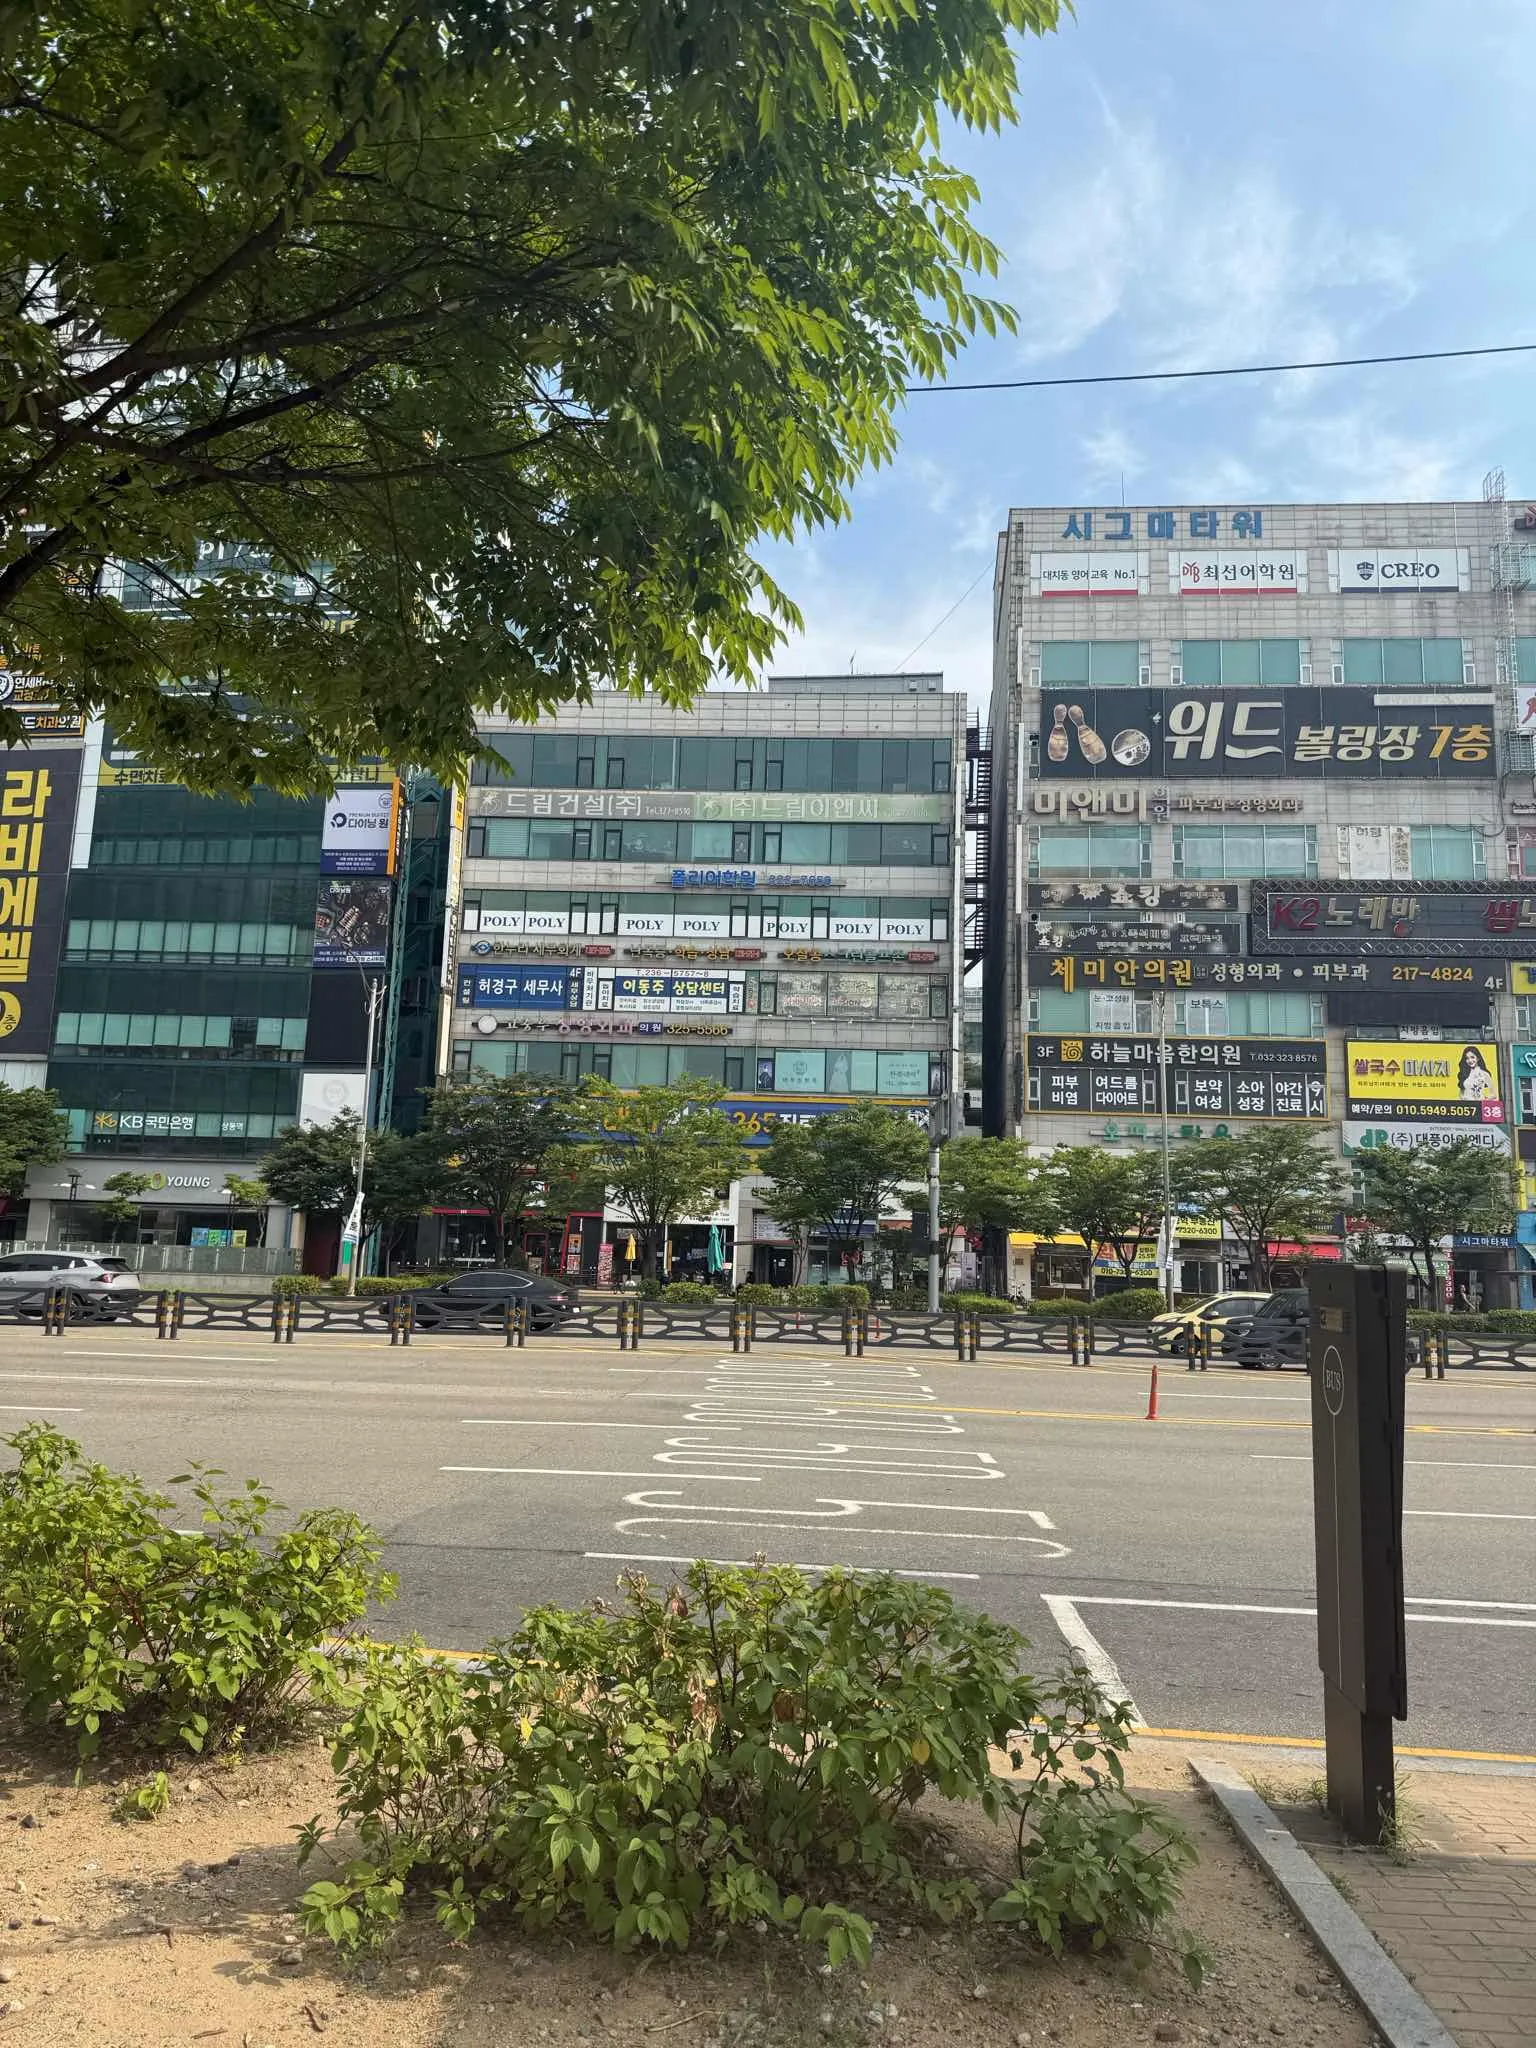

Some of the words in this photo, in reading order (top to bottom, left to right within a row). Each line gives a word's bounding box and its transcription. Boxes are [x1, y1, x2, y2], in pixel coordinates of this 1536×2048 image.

[1062, 510, 1263, 541] 시그마타워
[1042, 569, 1069, 580] 대치동
[1071, 569, 1108, 580] 영어교육
[1114, 568, 1136, 580] No.1
[1203, 564, 1294, 582] 최선어학원
[1380, 562, 1439, 579] CREO
[1164, 701, 1283, 760] 위드
[1294, 725, 1419, 761] 볼링장
[1428, 724, 1491, 761] 7층
[506, 793, 641, 817] 드림건설(주)
[1034, 788, 1147, 822] 미앤미
[672, 869, 756, 888] 폴리어학원
[483, 916, 520, 927] POLY
[528, 917, 565, 928] POLY
[1273, 896, 1321, 930] K2
[1325, 896, 1422, 938] 노래방
[626, 919, 664, 930] POLY
[683, 920, 720, 931] POLY
[767, 922, 808, 933] POLY
[835, 924, 873, 934] POLY
[886, 925, 925, 935] POLY
[569, 968, 582, 978] 4F
[1210, 963, 1284, 982] 성형외과
[1312, 963, 1369, 981] 피부과
[1392, 967, 1473, 981] 217-4824
[478, 978, 518, 995] 허경구
[523, 980, 564, 996] 세무사
[622, 979, 665, 995] 이동주
[672, 981, 725, 996] 상담센터
[1485, 977, 1503, 989] 4F
[639, 1023, 662, 1033] 의원
[1037, 1046, 1054, 1057] 3F
[1090, 1044, 1241, 1065] 하늘마음한의원
[1354, 1058, 1400, 1076] 쌀국수
[1051, 1076, 1079, 1088] 피부
[1095, 1076, 1138, 1090] 여드름
[1194, 1080, 1222, 1093] 보약
[1236, 1080, 1264, 1094] 소아
[1275, 1081, 1303, 1095] 야간
[1052, 1092, 1078, 1105] 비염
[1095, 1092, 1139, 1106] 다이어트
[1195, 1095, 1222, 1109] 여성
[1237, 1097, 1265, 1111] 성장
[1275, 1097, 1303, 1112] 진료
[1351, 1104, 1392, 1115] 예약/문의
[1396, 1105, 1477, 1117] 010.5949.5057
[1483, 1106, 1502, 1118] 3층
[167, 1176, 211, 1187] YOUNG
[1462, 1237, 1509, 1246] 시그마타워
[1326, 1369, 1340, 1391] BUS
